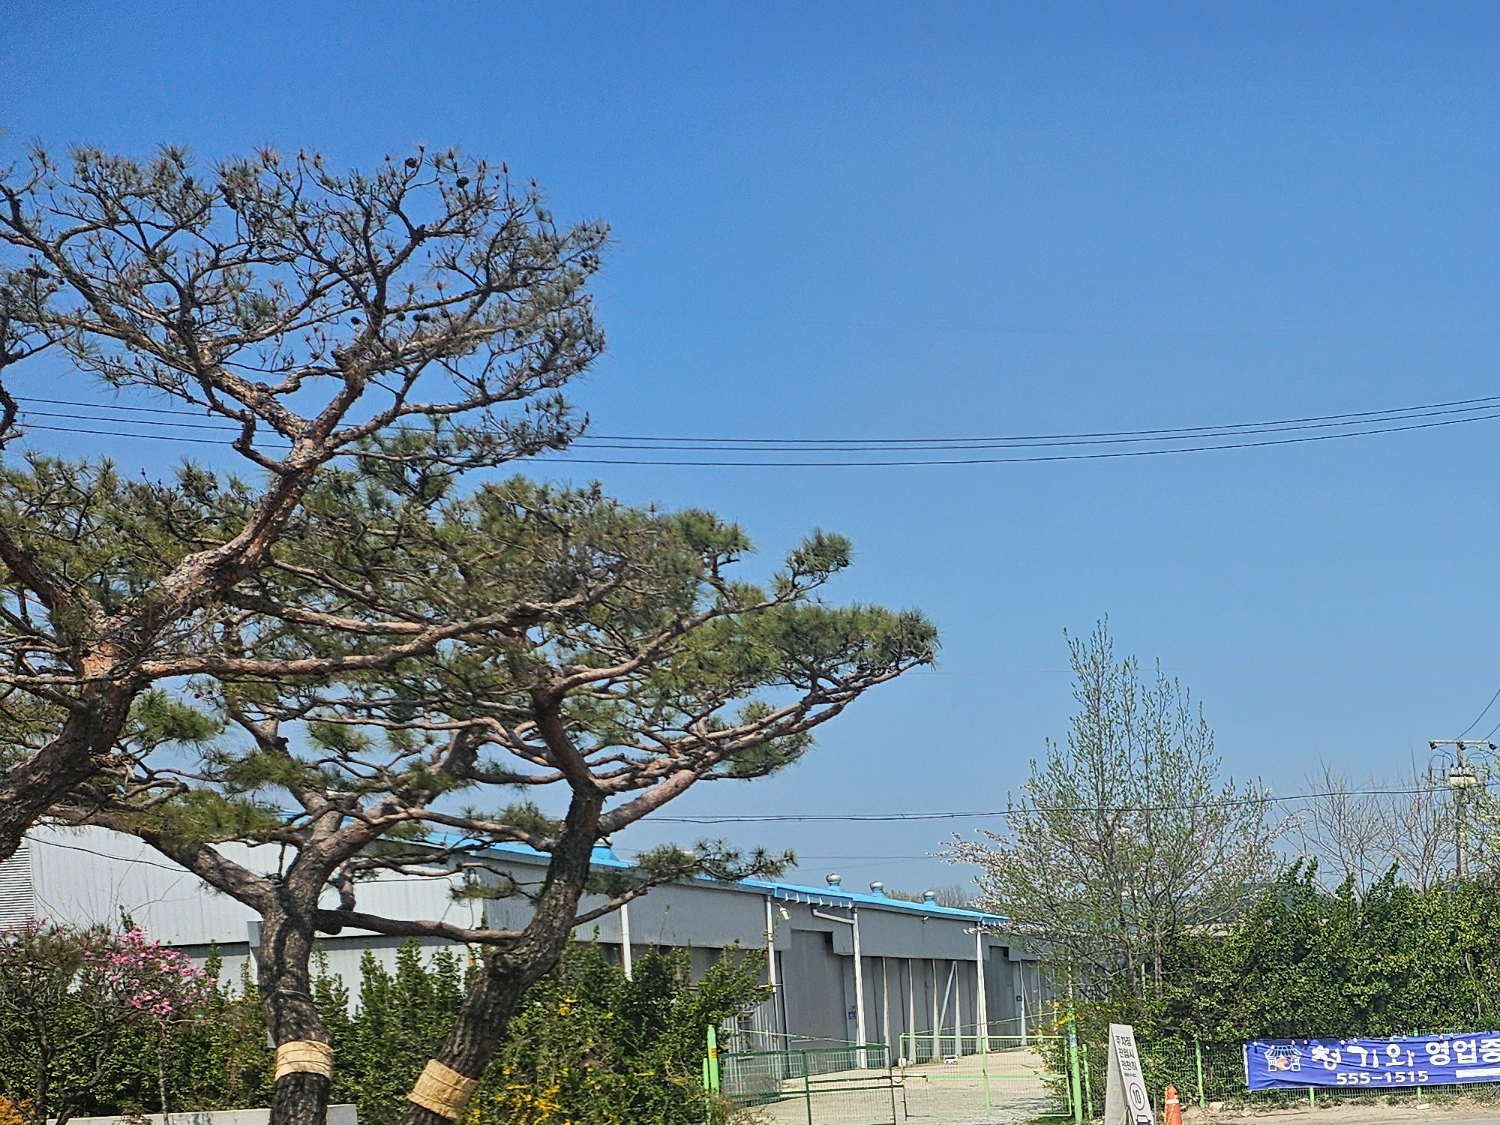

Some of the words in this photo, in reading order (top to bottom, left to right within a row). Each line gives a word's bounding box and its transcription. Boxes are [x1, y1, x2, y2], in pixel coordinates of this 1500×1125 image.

[1311, 1043, 1416, 1070] 청기와
[1336, 1070, 1429, 1085] 555-1515
[1132, 1089, 1141, 1104] 10
